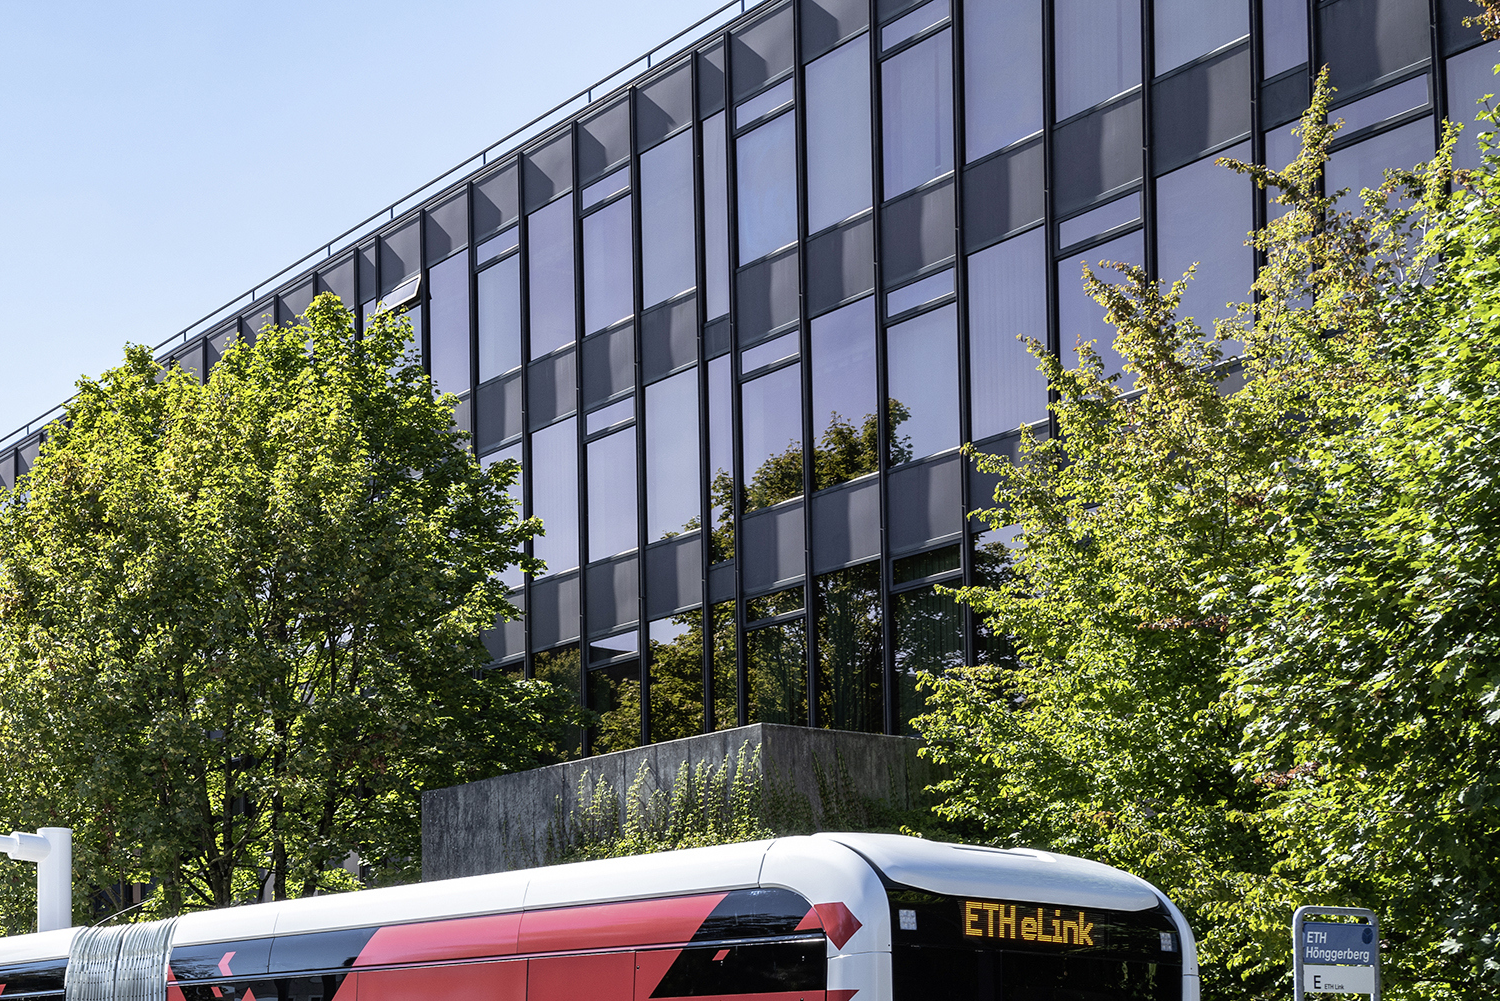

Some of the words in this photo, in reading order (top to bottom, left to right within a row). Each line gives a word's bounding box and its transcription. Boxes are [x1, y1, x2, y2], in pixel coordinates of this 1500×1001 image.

[966, 901, 1016, 939] ETH
[1021, 907, 1094, 946] eLink
[1306, 931, 1327, 944] ETH
[1305, 946, 1370, 963] Hönggerberg
[1313, 975, 1322, 989] E
